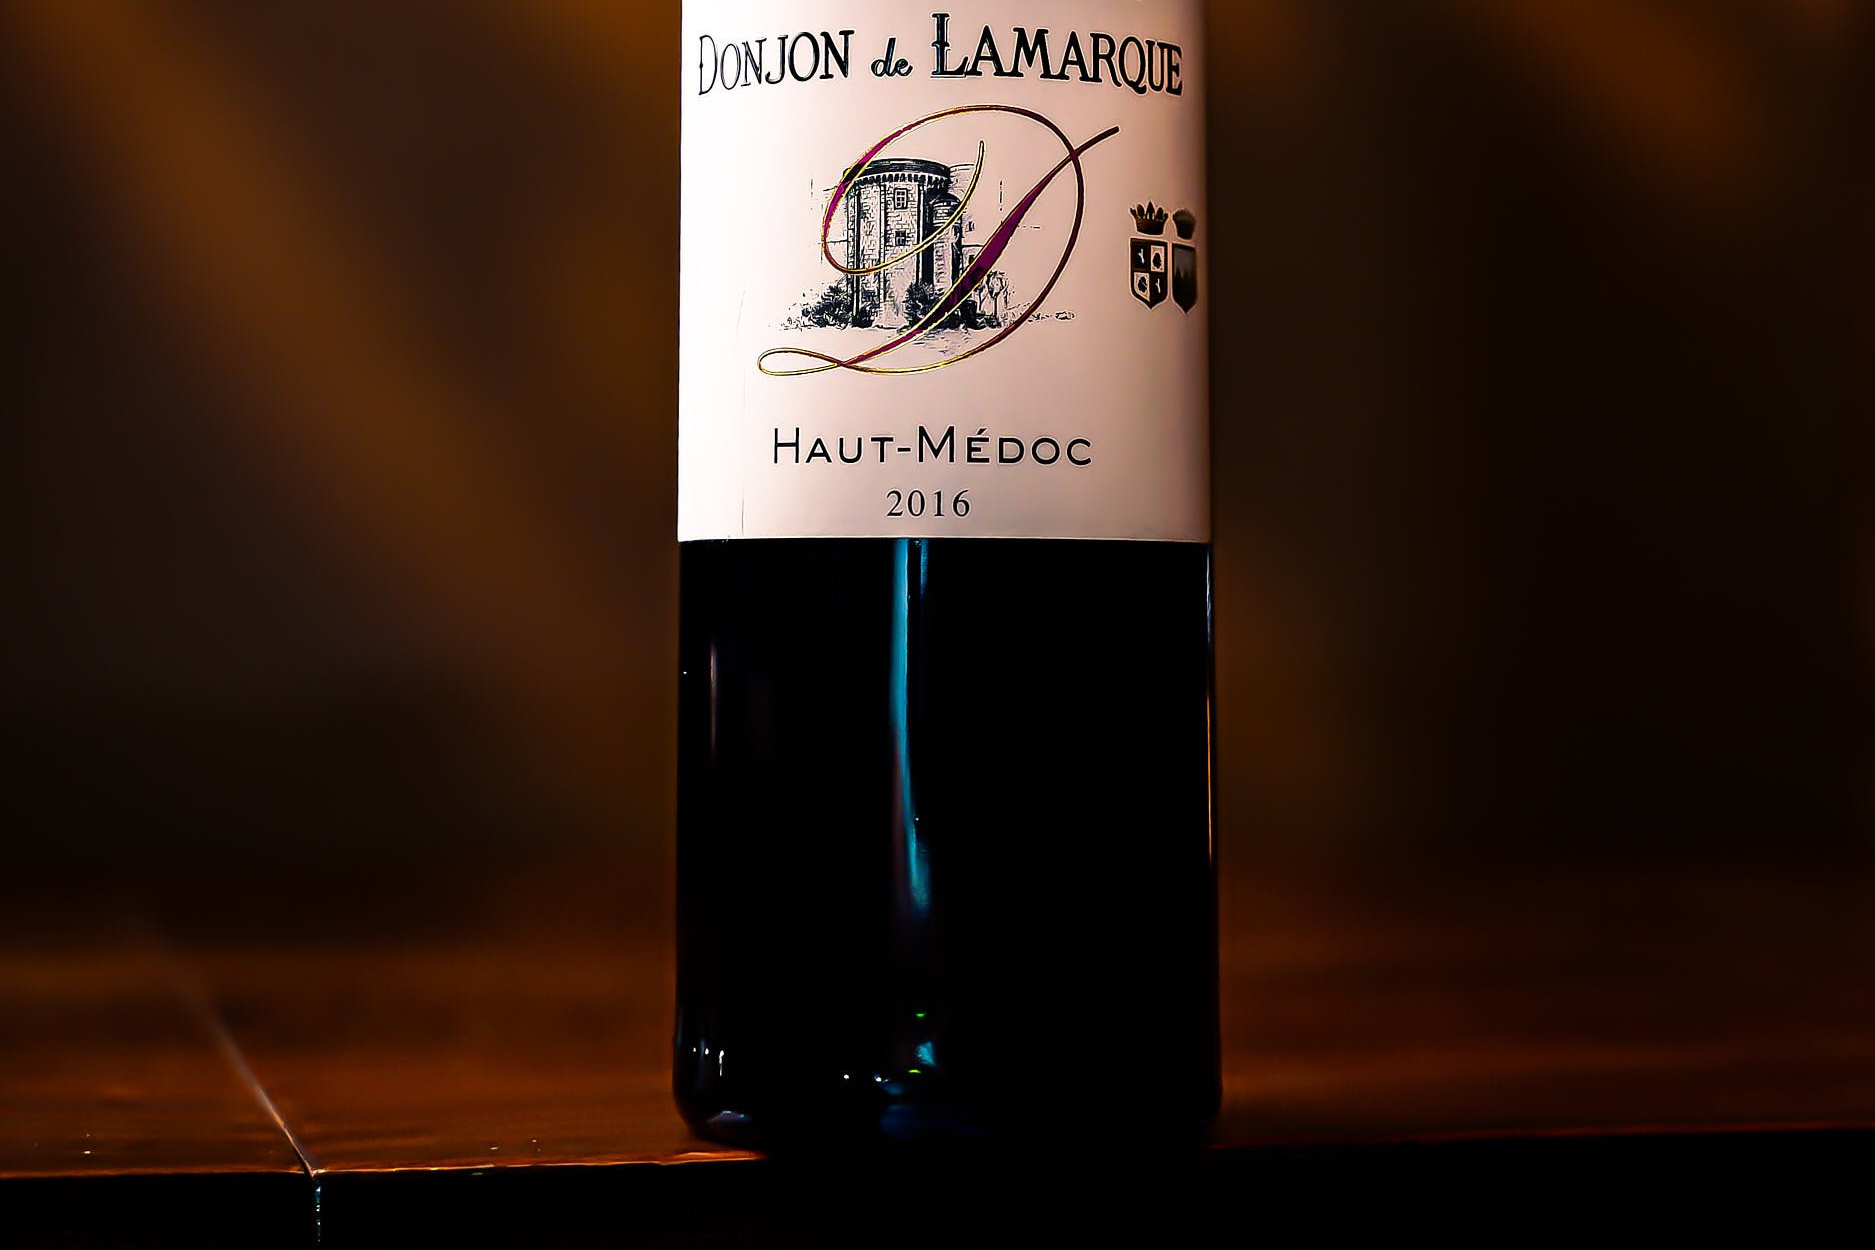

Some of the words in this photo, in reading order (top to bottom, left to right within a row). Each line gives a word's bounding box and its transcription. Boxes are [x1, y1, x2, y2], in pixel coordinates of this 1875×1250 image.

[698, 29, 855, 96] DONJON
[870, 37, 914, 77] de
[930, 12, 1184, 97] LAMARQUE
[773, 425, 1093, 467] HAUT-MÉDOC
[885, 489, 971, 518] 2016
